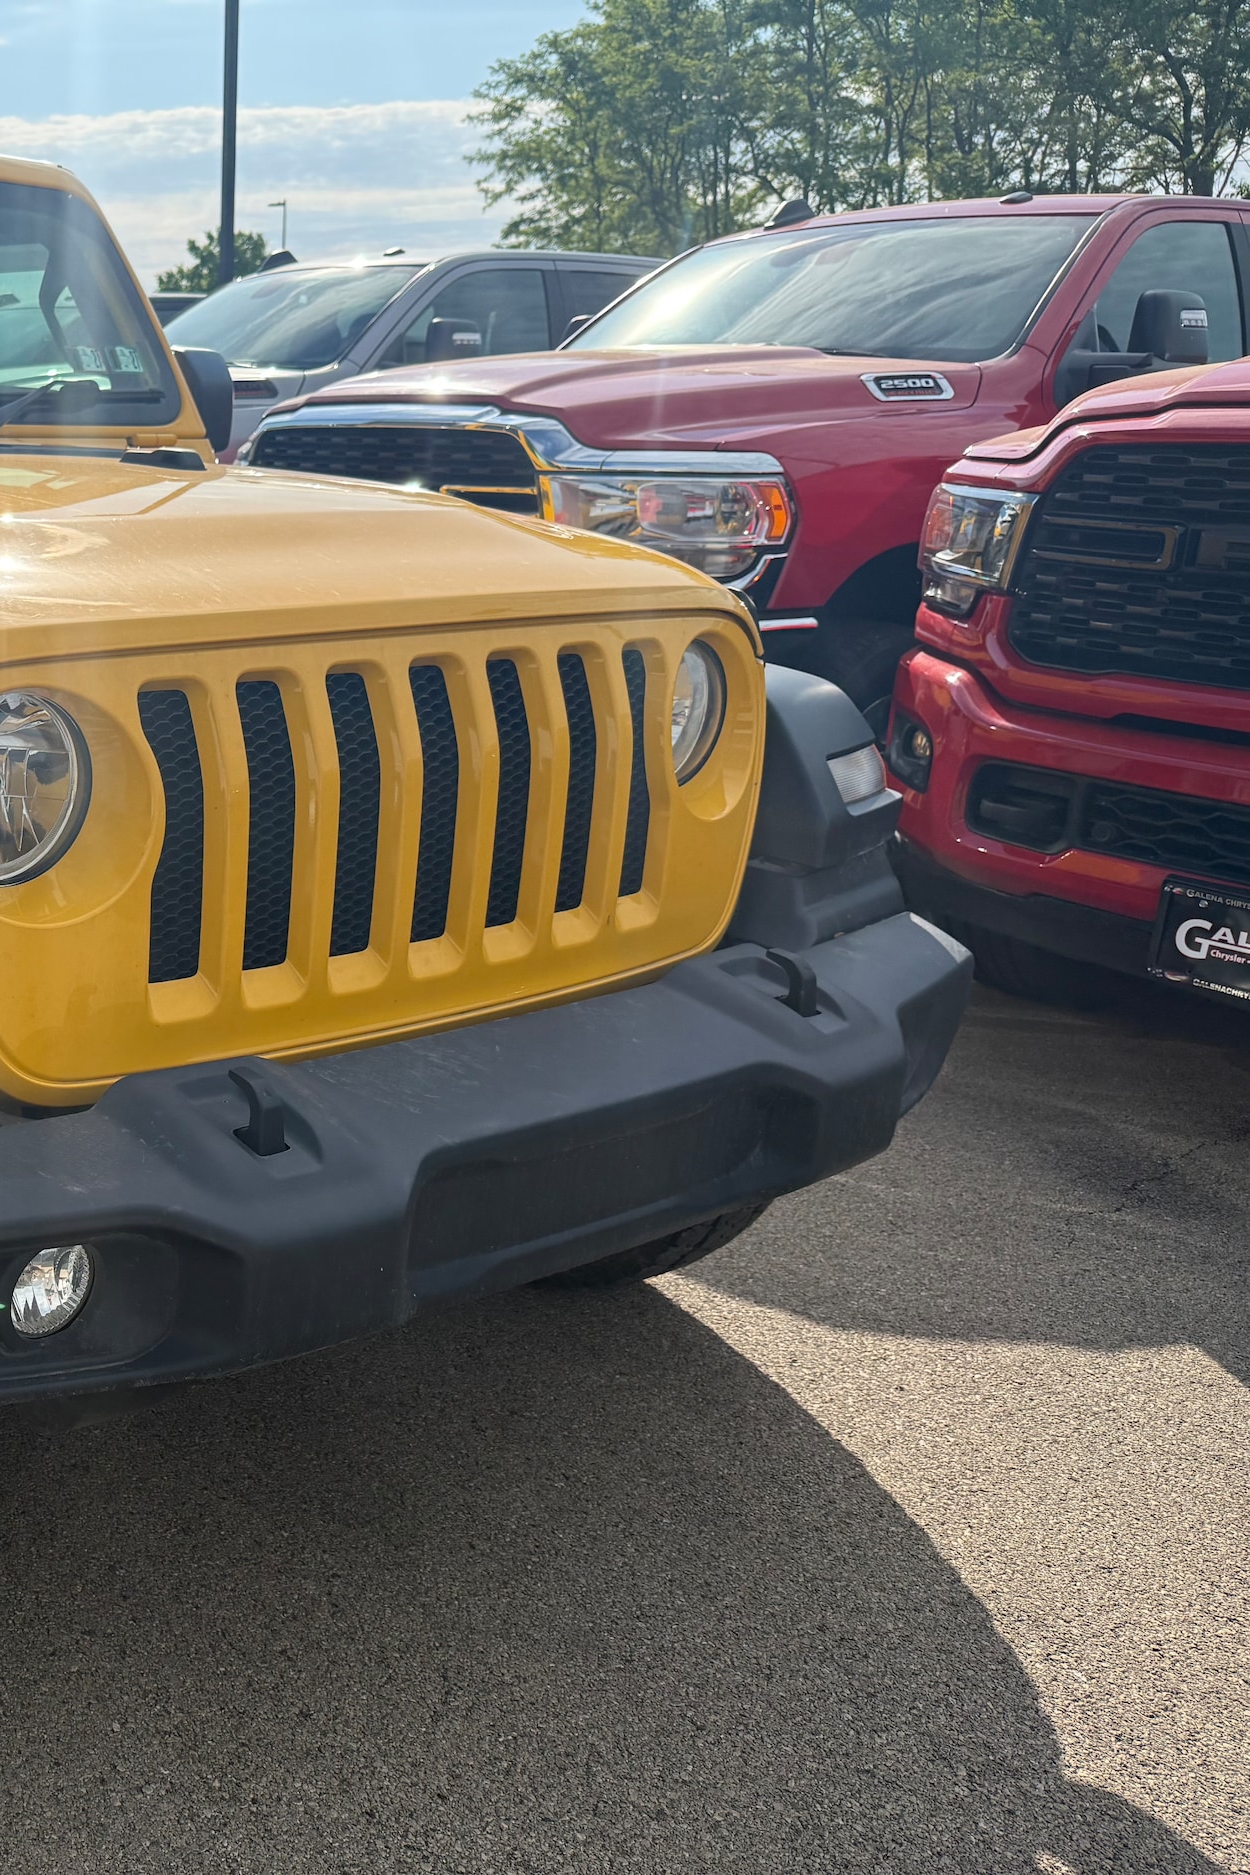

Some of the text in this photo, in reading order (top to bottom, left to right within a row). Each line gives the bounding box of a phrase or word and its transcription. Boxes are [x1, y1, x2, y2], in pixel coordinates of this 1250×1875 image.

[880, 378, 935, 389] 2500
[1186, 889, 1224, 904] GALENA
[1210, 949, 1246, 964] Chrysler
